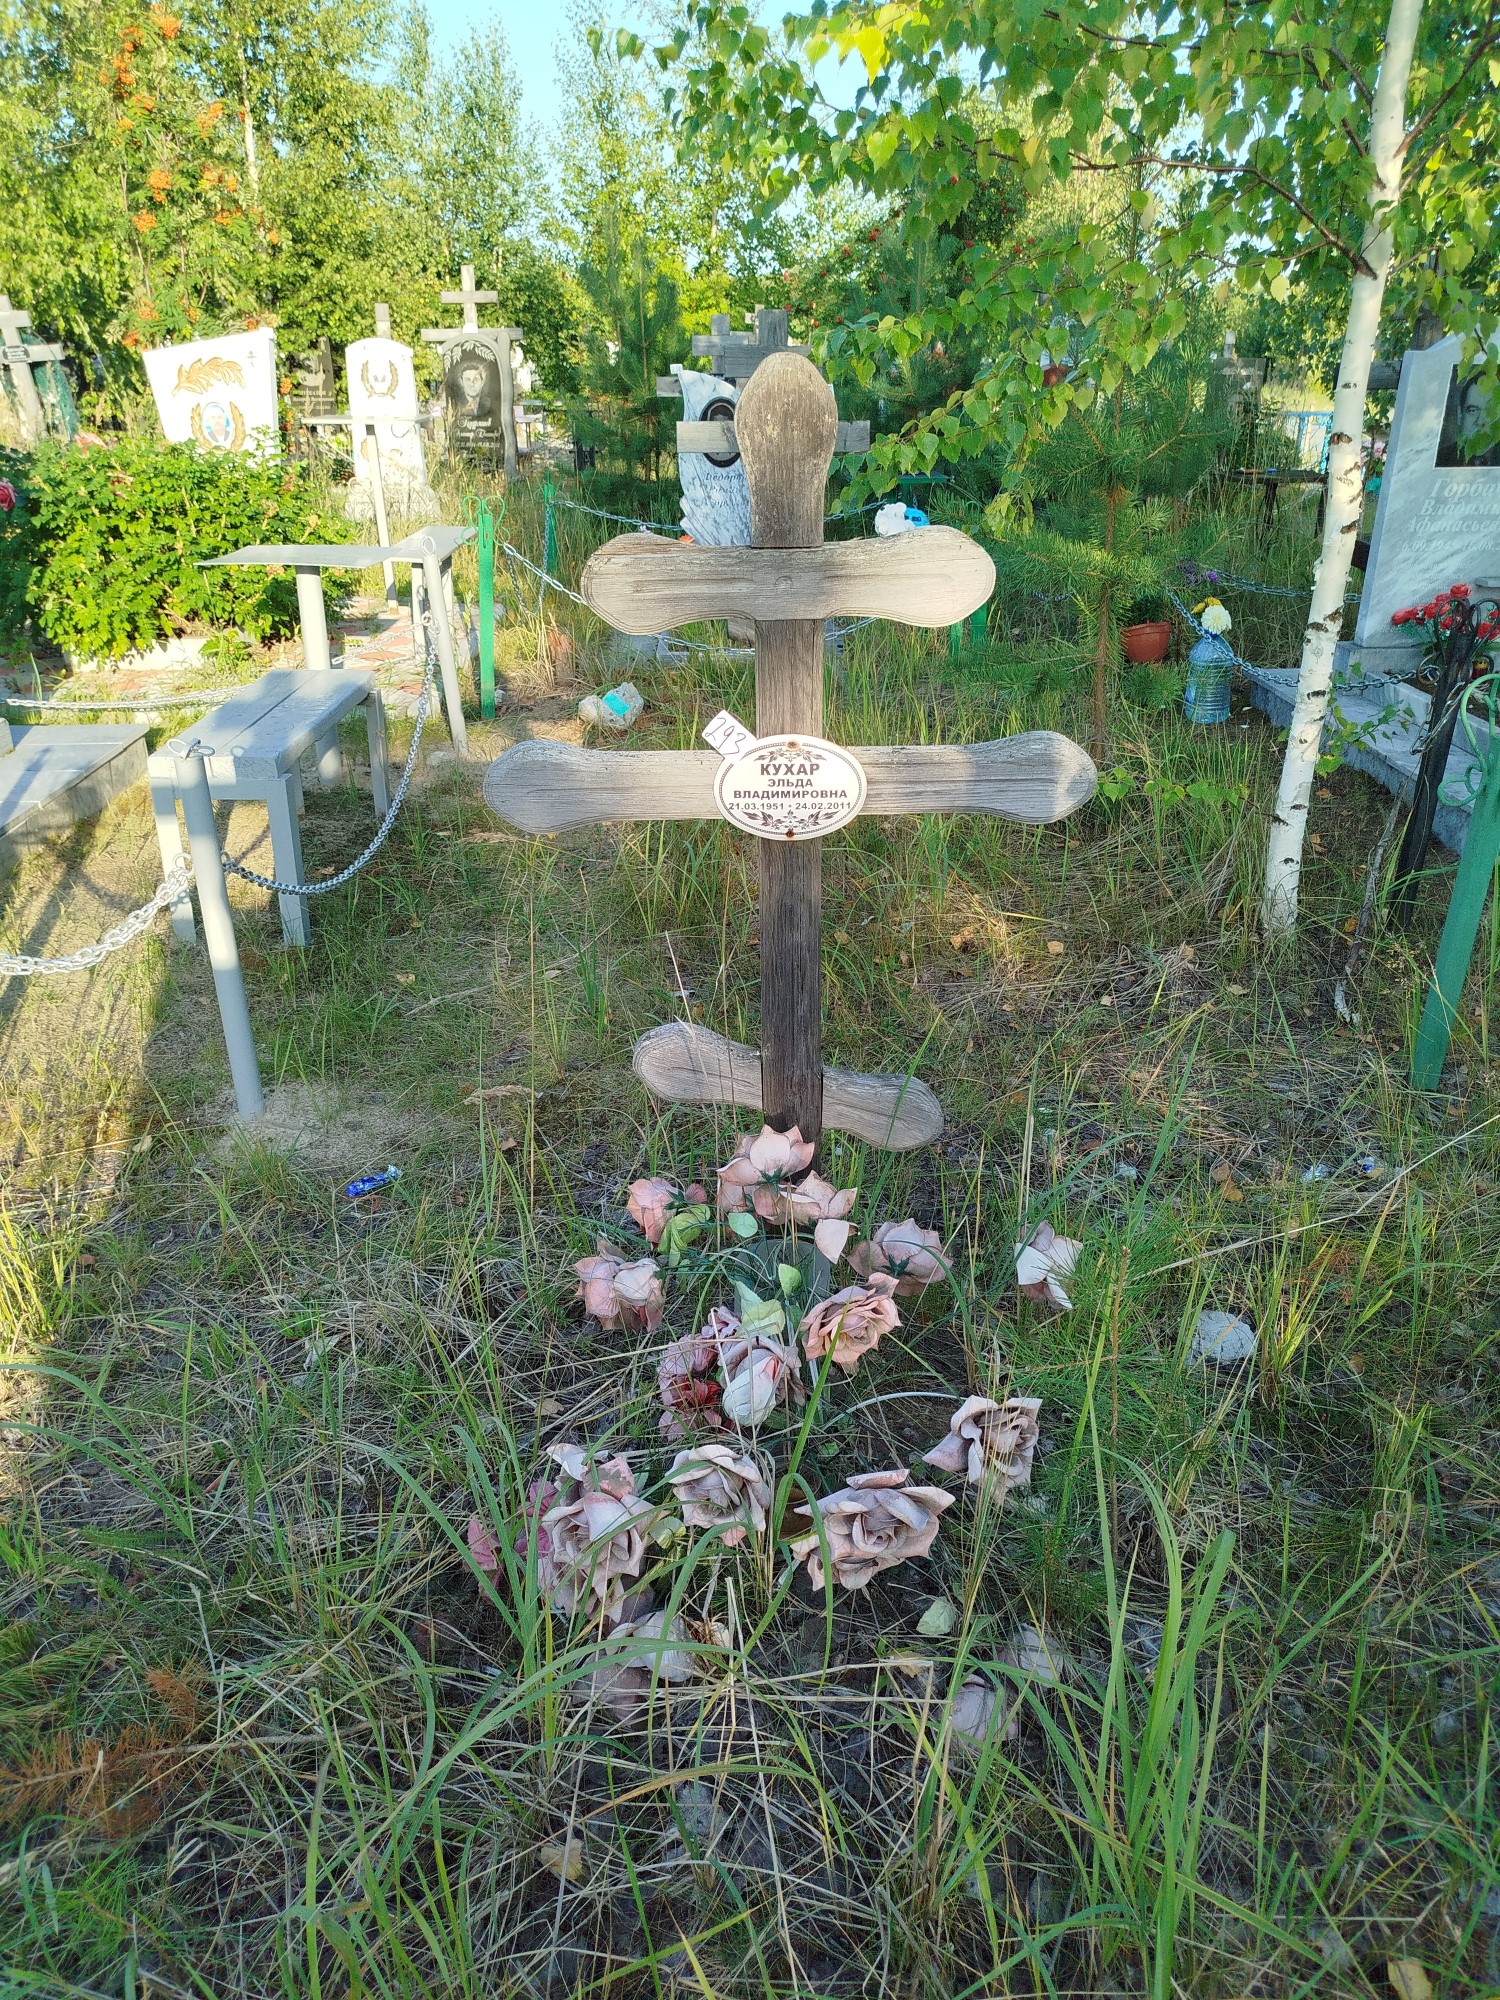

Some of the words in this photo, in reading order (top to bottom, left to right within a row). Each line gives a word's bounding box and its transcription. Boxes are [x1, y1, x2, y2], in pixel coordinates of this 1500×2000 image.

[704, 716, 747, 756] 293
[760, 763, 820, 776] КУХАР
[767, 778, 814, 789] ЭЛЬДА
[733, 789, 848, 801] ВЛАДИМИРОВНА
[728, 802, 784, 811] 21.03.1951
[795, 801, 852, 811] 24.02.2011
